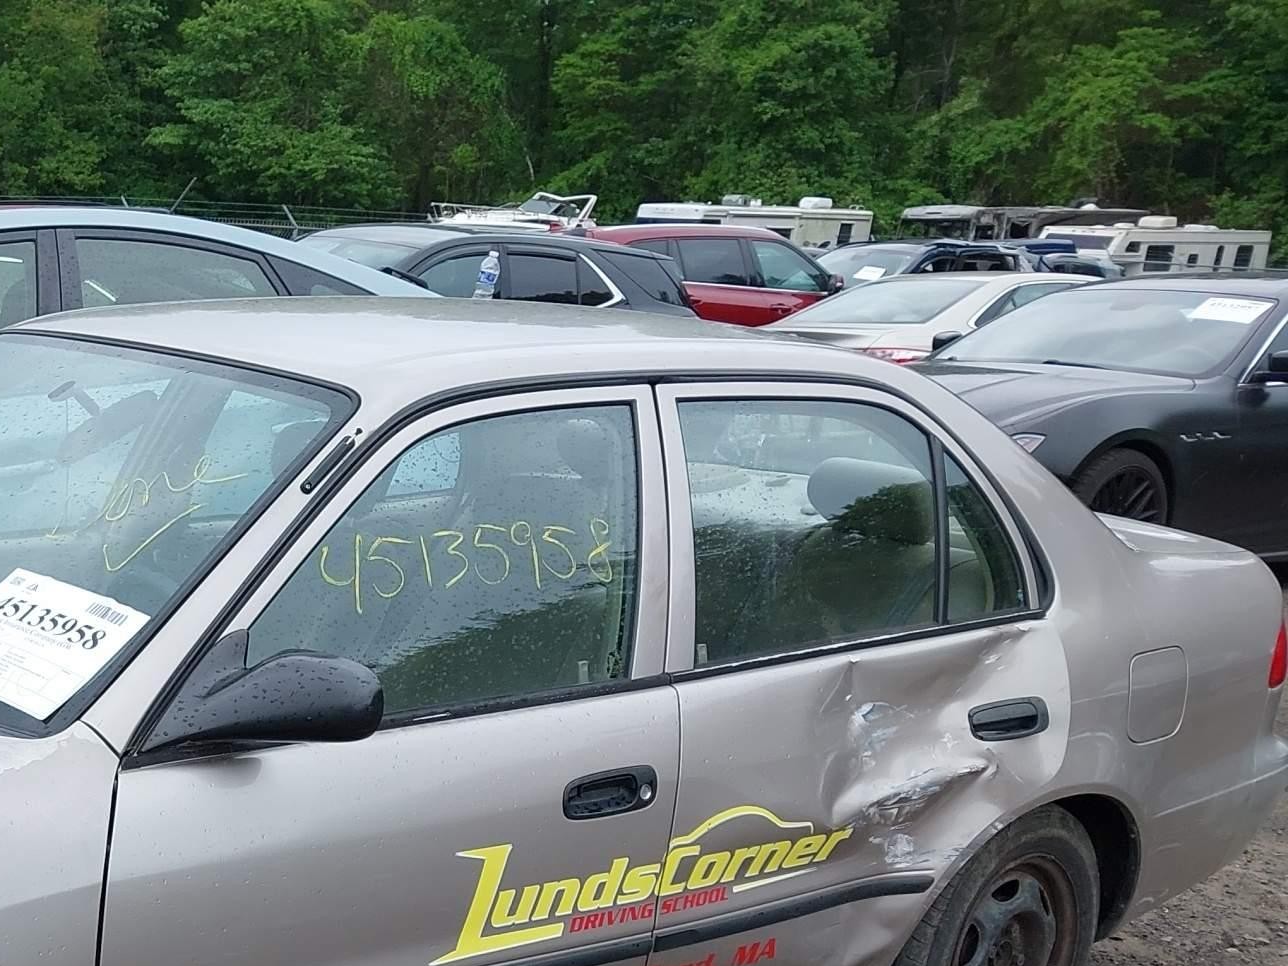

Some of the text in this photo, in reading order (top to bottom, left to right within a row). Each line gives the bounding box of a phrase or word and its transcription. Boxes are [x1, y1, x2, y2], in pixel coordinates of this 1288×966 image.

[319, 517, 614, 615] 45135958
[568, 885, 730, 934] DRIVING SCHOOL
